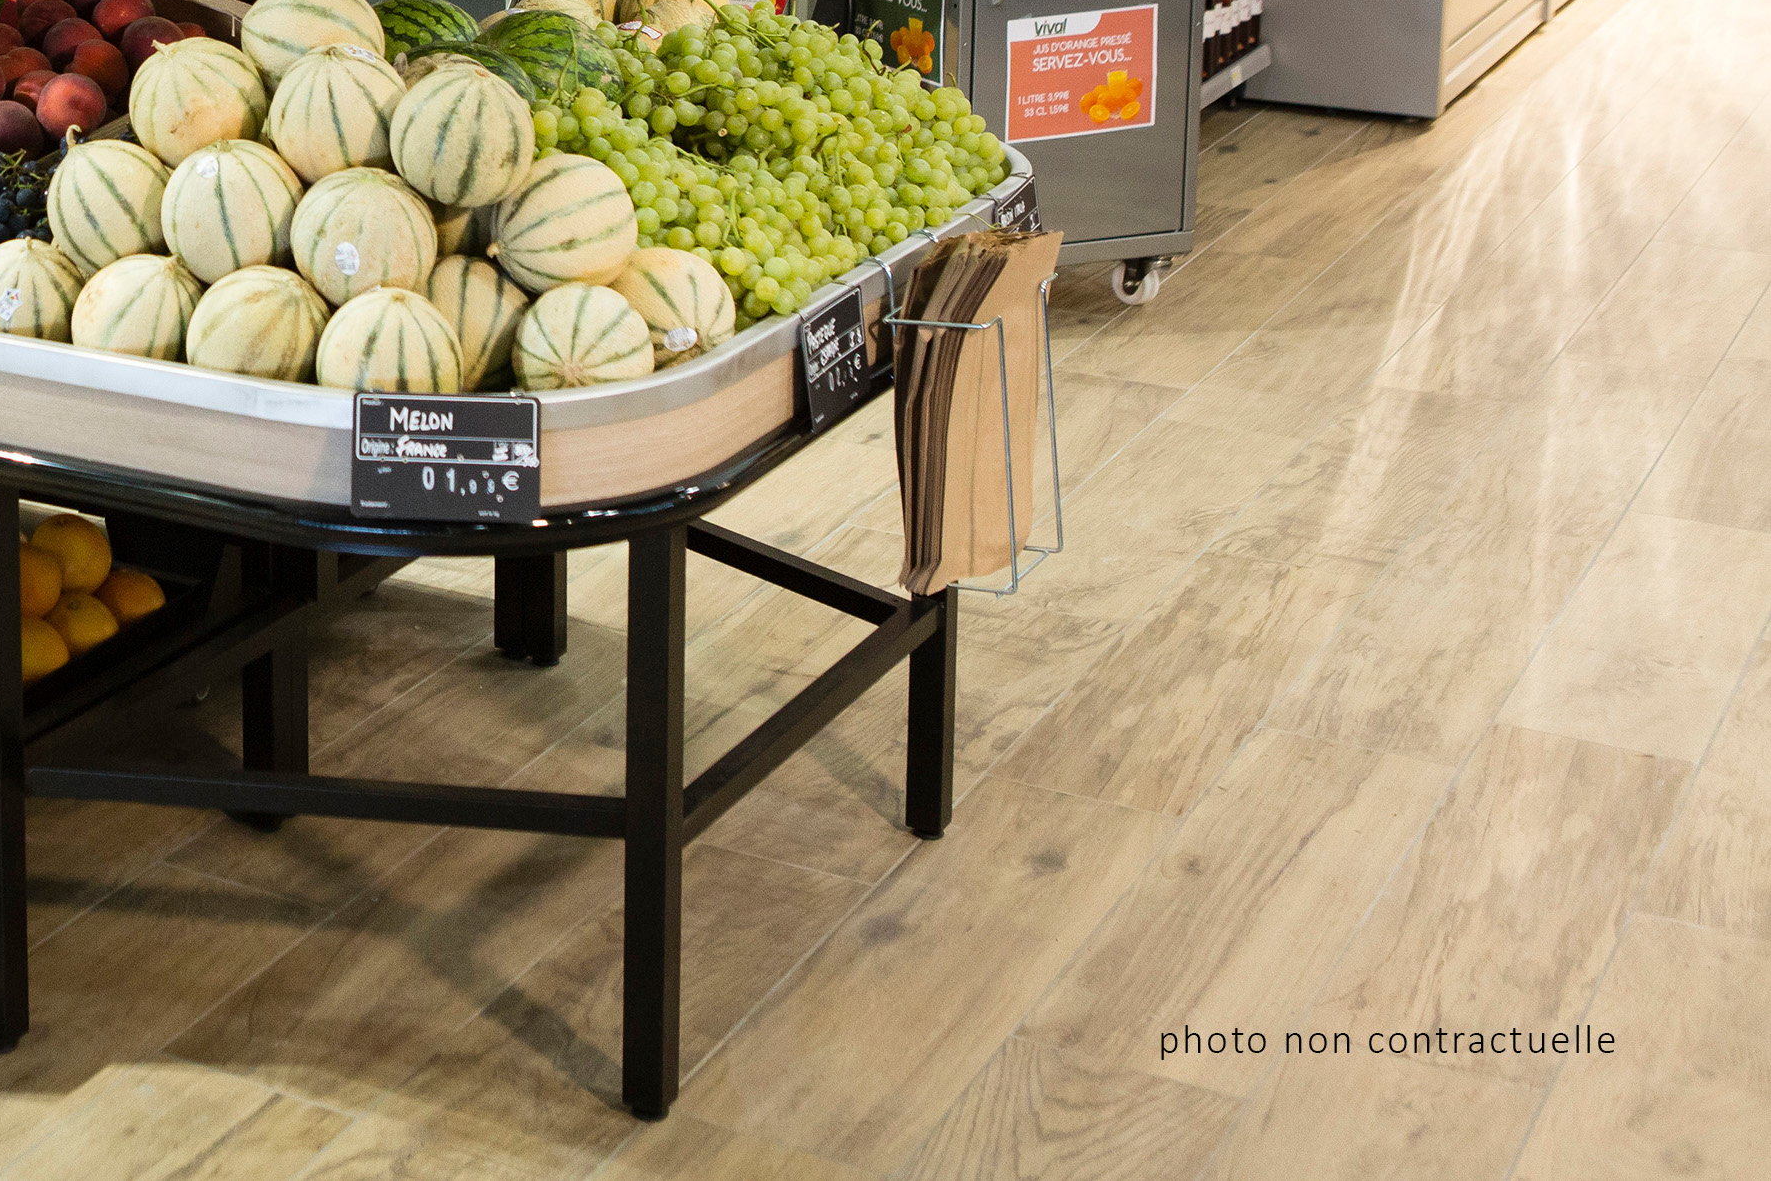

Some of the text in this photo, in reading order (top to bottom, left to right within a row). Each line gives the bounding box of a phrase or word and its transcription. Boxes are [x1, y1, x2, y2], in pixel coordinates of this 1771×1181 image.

[1032, 32, 1132, 55] JUS D'ORANGE PRESSÉ
[1032, 50, 1132, 72] SERVEZ-VOUS...
[1022, 94, 1046, 105] LITRE
[1024, 108, 1035, 118] 33
[1036, 107, 1047, 116] CL
[389, 405, 454, 432] MELON
[361, 435, 448, 458] Origine: FRANCE
